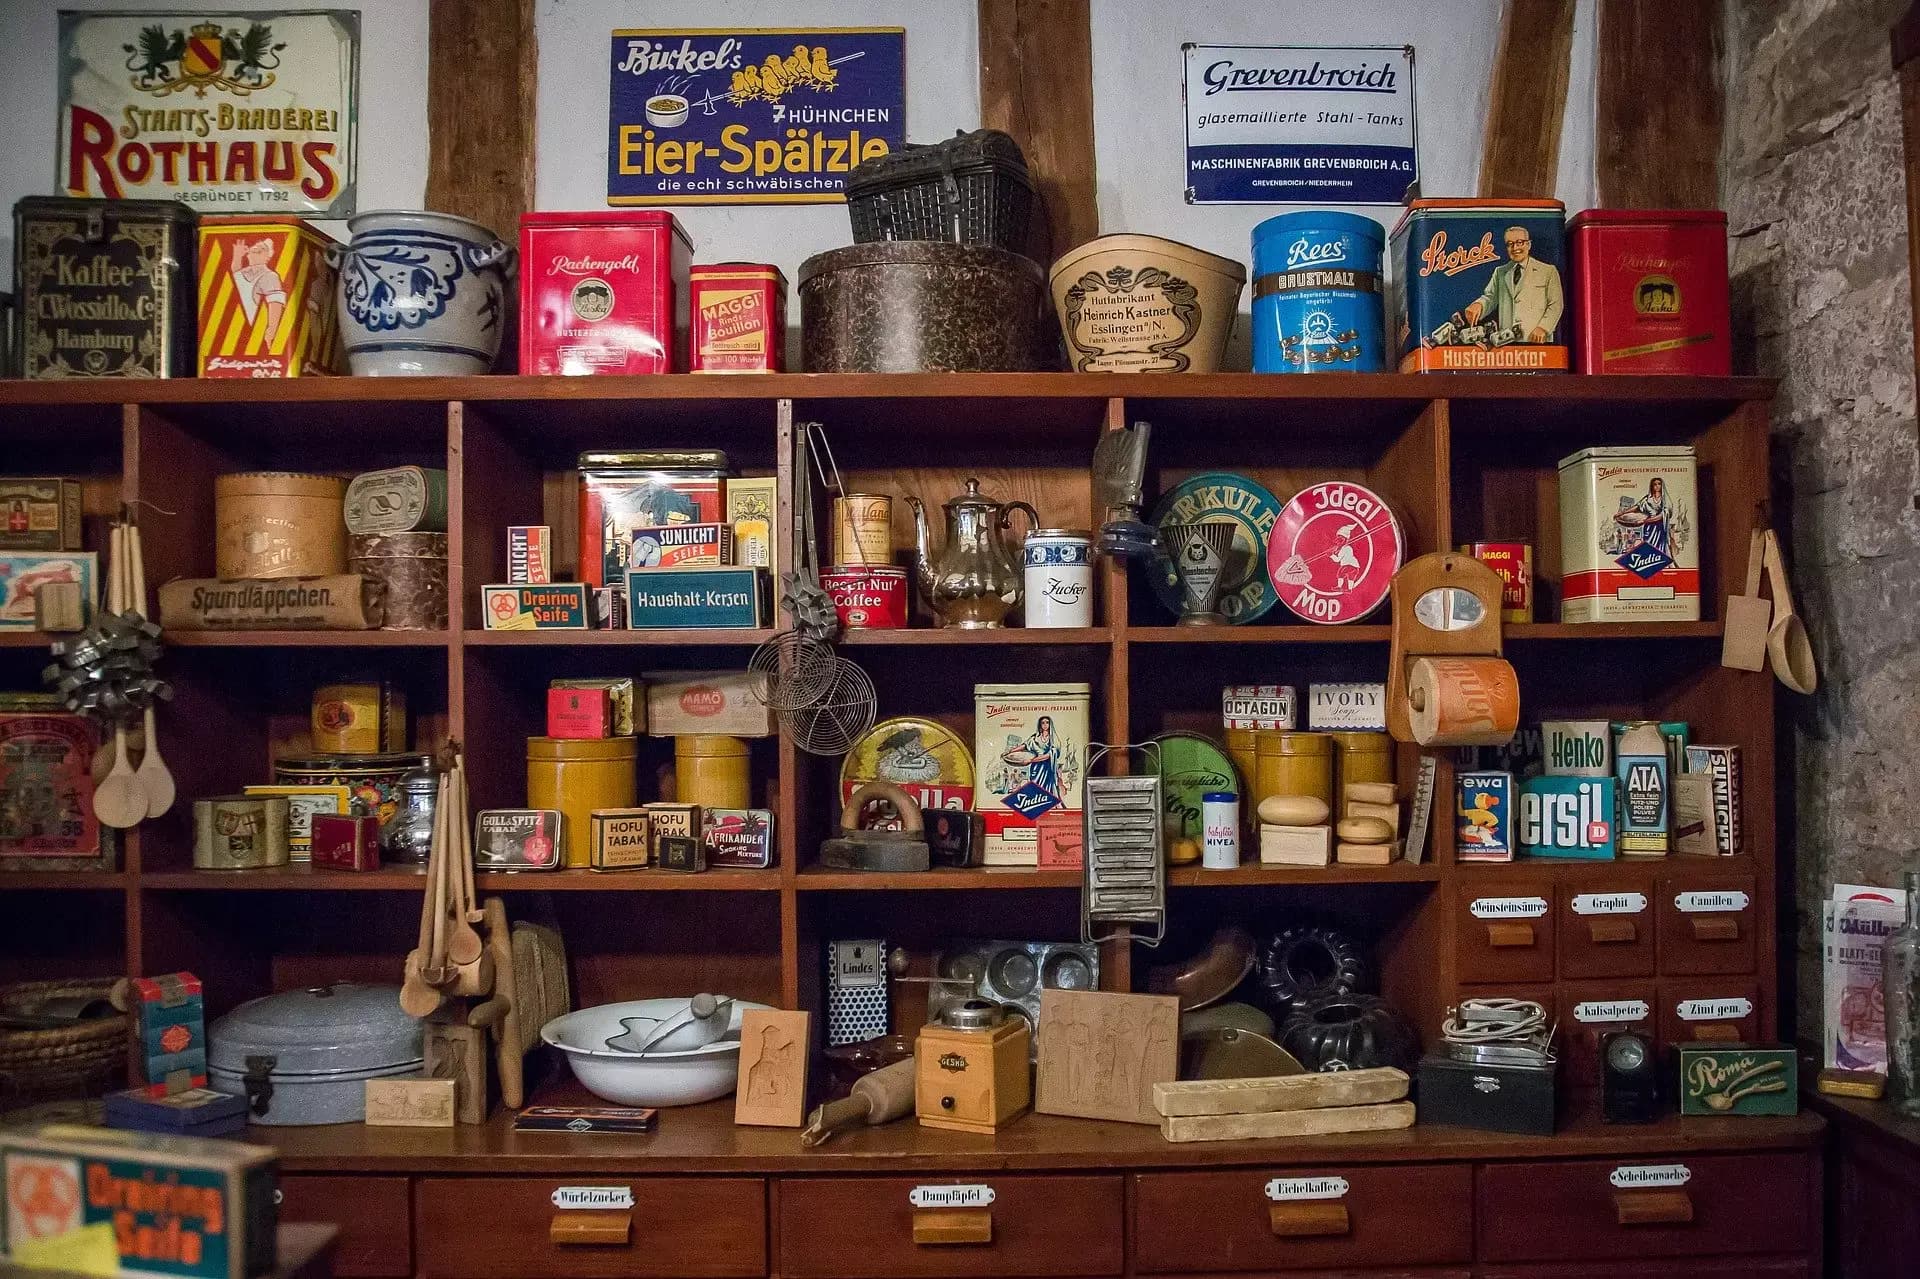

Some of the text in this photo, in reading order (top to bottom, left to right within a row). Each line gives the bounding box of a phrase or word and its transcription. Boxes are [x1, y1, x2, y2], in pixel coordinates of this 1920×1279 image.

[618, 38, 742, 75] Birkel's
[1203, 60, 1396, 96] Grevenbroich
[120, 104, 338, 138] STAATS-BRAUEREI
[773, 105, 890, 123] 7 HÜHNCHEN
[1198, 111, 1307, 128] glasemaillierte
[67, 105, 338, 200] ROTHAUS
[619, 123, 891, 177] Eier-Spätzle
[1191, 158, 1301, 171] MASCHINENFABRIK
[1304, 159, 1388, 171] GREVENBROICH
[657, 176, 845, 192] die echt schwäbischen
[1252, 179, 1353, 188] GREVENBROICH/NIEDERRHEIN
[173, 191, 289, 203] GEGRÜNDET 1792
[1287, 240, 1343, 266] Rees
[1420, 230, 1498, 276] Storck
[56, 255, 136, 287] Kaffee
[547, 254, 640, 276] Rachengold
[1278, 271, 1355, 290] BRUSTMALZ
[1091, 293, 1155, 305] Hutfabrikant
[1083, 306, 1171, 322] Heinrich Kastner
[710, 318, 761, 340] Bouillon
[1091, 322, 1144, 335] Esslingen
[56, 328, 135, 353] Hamburg
[1151, 356, 1159, 364] 27
[1443, 348, 1546, 367] Hustendoktor
[1312, 487, 1382, 522] Ideal
[658, 527, 715, 546] SUNLICHT
[511, 532, 528, 586] NLICHT
[672, 544, 706, 562] SEIFE
[1482, 551, 1511, 560] MAGGI
[528, 543, 545, 582] SEIFE
[1628, 553, 1662, 576] India
[191, 584, 336, 614] Spundläppchen.
[523, 590, 578, 609] Dreiring
[638, 590, 749, 608] Haushalt-Kerzen
[834, 593, 882, 608] Coffee
[1292, 588, 1341, 620] Mop
[533, 607, 569, 623] Seife
[683, 692, 721, 704] MAMÖ
[1317, 692, 1379, 706] IVORY
[1225, 701, 1286, 716] OCTAGON
[1552, 732, 1604, 768] Henko
[1458, 778, 1502, 788] ewa
[1628, 766, 1662, 792] ATA
[1014, 794, 1048, 809] India
[1710, 754, 1730, 850] SUNLICHT
[610, 822, 643, 833] HOFU
[653, 815, 685, 825] HOFU
[608, 835, 645, 847] TABAK
[705, 830, 764, 848] AFRIKANDER
[719, 845, 747, 855] SMOKING
[737, 850, 763, 858] MIXTURE
[1474, 901, 1543, 914] Weinsteinsäure
[1592, 897, 1628, 910] Graphit
[1584, 1005, 1641, 1018] Kalisalpeter
[1690, 1003, 1741, 1017] Zimt gem.
[1688, 1057, 1756, 1096] Roma
[561, 1191, 626, 1202] Würfelzucker
[1278, 1182, 1339, 1194] Eichelkaffee
